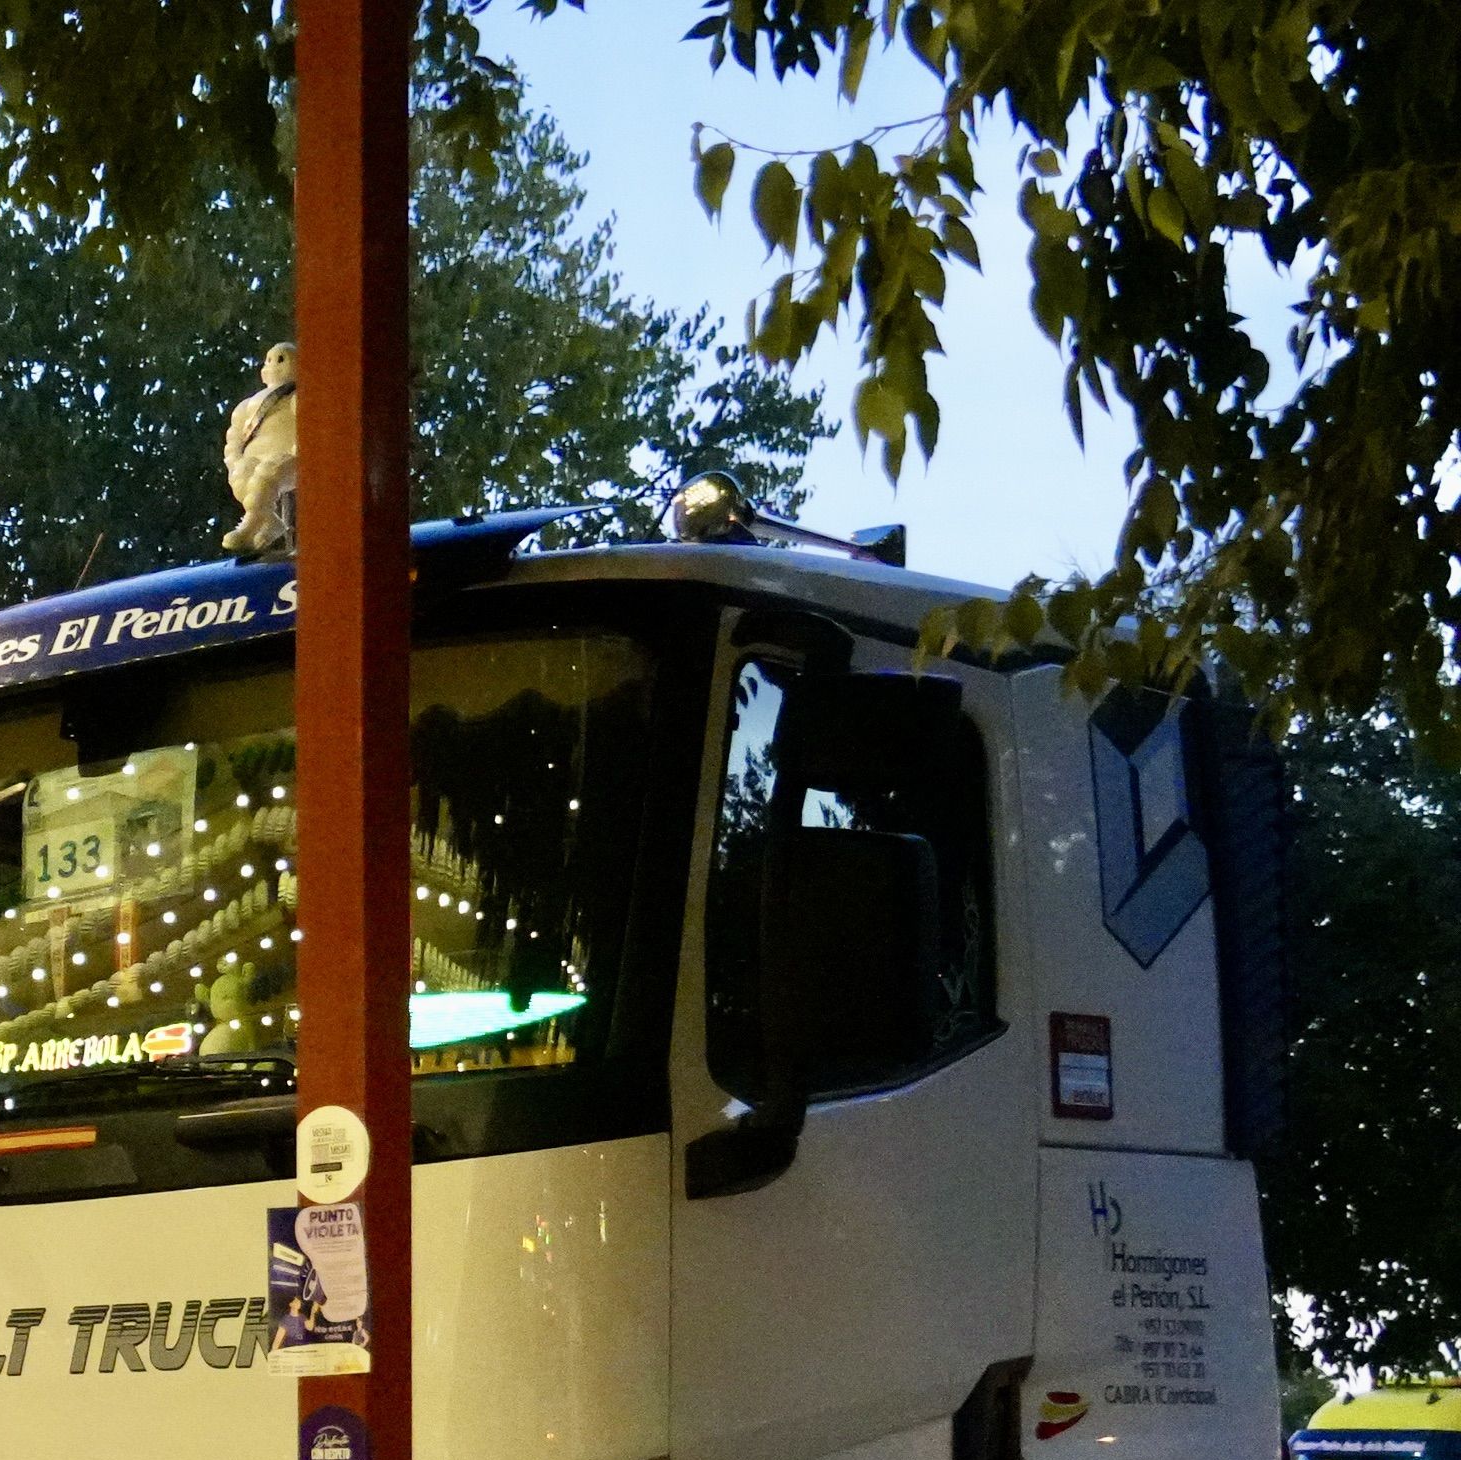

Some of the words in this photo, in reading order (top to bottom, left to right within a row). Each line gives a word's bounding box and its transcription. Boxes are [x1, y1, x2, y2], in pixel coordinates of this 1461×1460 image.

[49, 616, 97, 656] El
[104, 594, 256, 646] Peñon,
[38, 835, 102, 882] 133
[304, 1223, 359, 1238] VIOLETA
[309, 1208, 354, 1223] PUNTO
[1112, 1242, 1207, 1281] Hormigones
